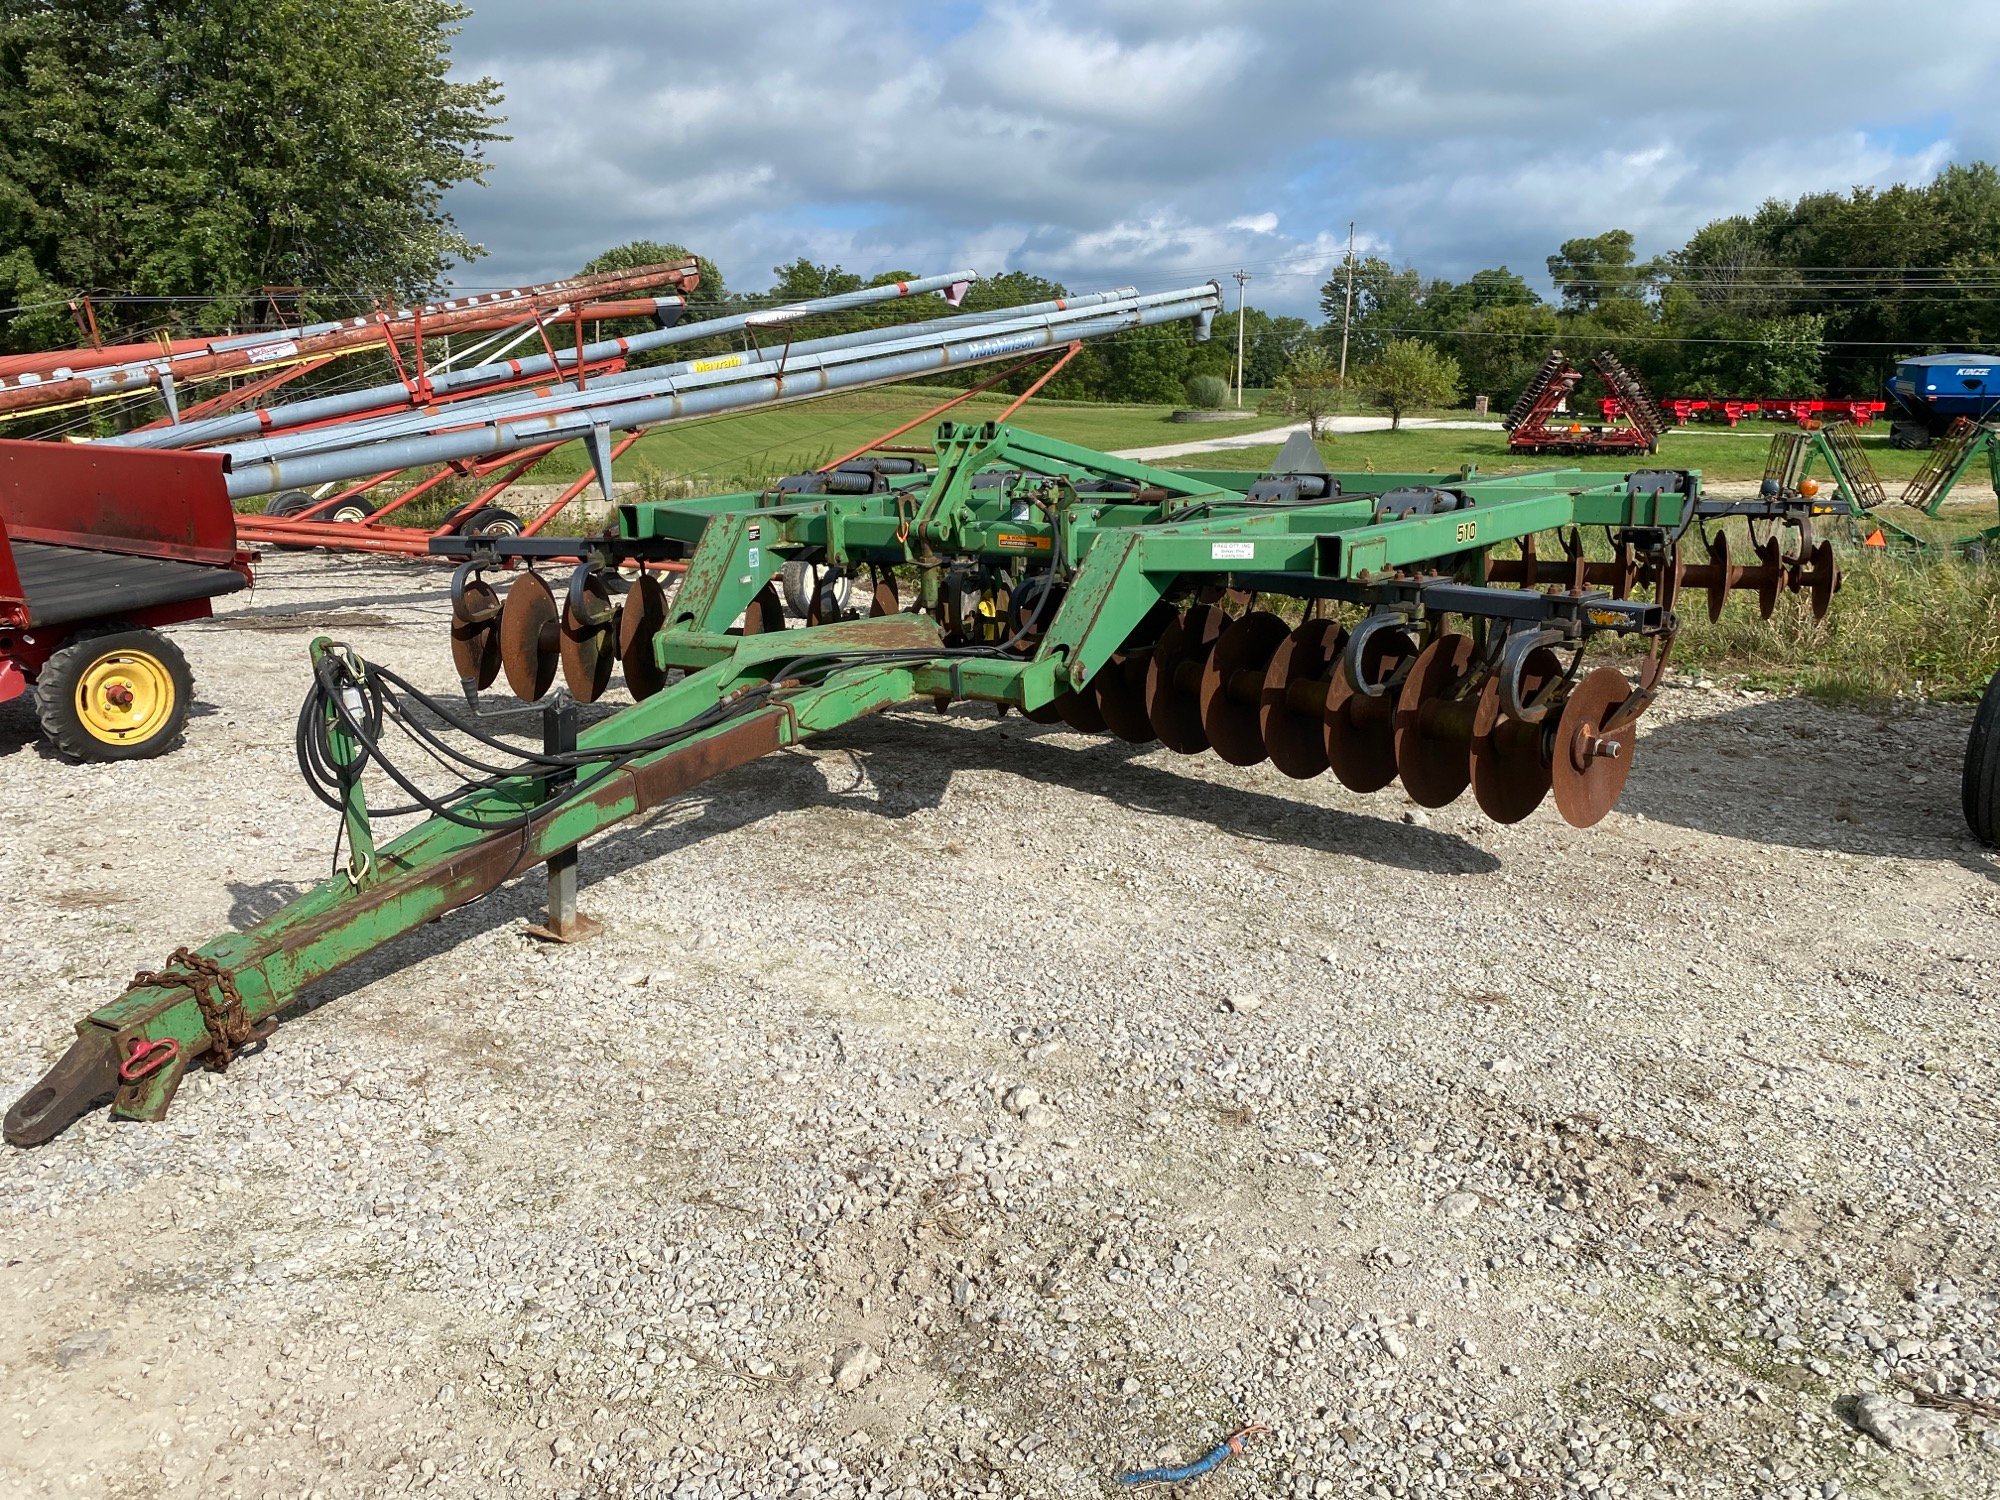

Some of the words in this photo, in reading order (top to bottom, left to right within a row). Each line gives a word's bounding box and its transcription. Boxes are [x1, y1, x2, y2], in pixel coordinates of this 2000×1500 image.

[968, 335, 1035, 359] Hutchinson
[694, 356, 742, 372] Mayrath
[1955, 368, 1991, 376] KINZE
[1456, 521, 1476, 544] 510
